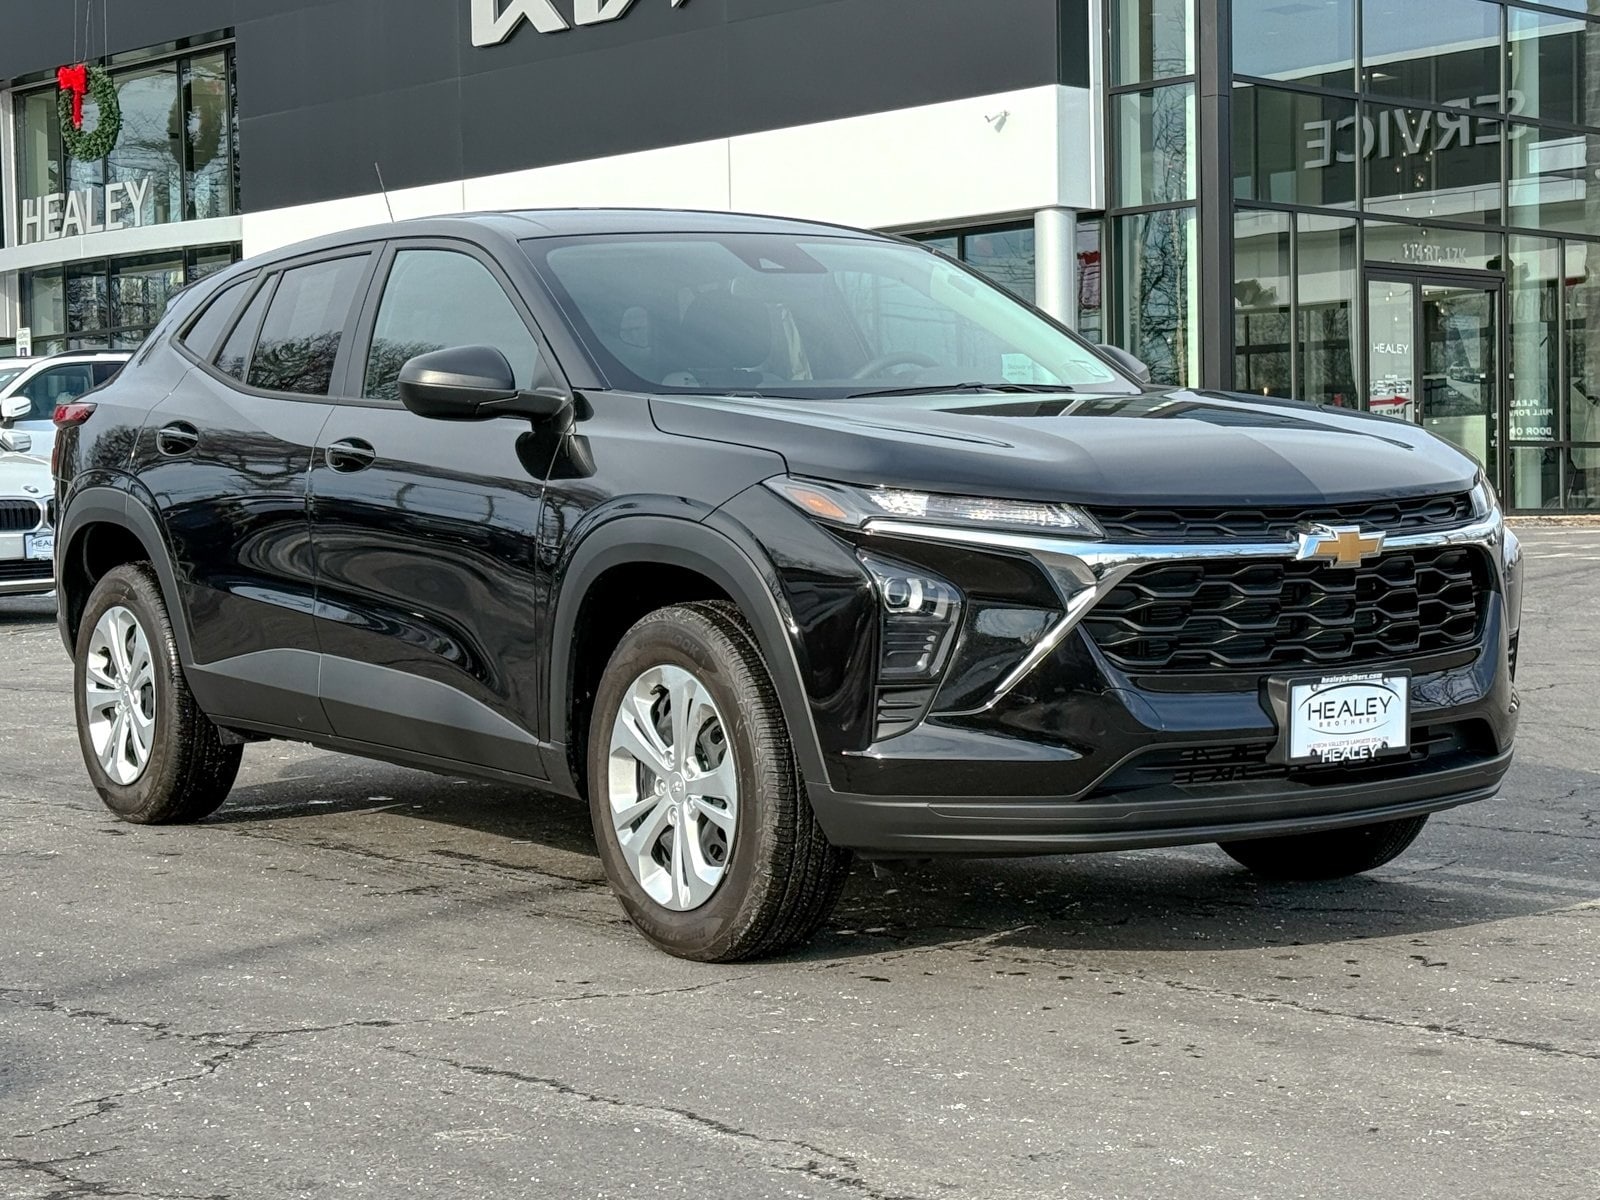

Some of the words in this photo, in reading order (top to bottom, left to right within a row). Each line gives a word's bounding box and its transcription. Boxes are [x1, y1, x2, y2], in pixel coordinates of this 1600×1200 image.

[22, 178, 149, 244] HEALEY
[1372, 343, 1409, 354] HEALEY
[31, 540, 53, 548] HEAL
[1307, 695, 1393, 720] HEALEY
[1318, 717, 1378, 728] BROTHERS
[1321, 743, 1378, 763] HEALEY
